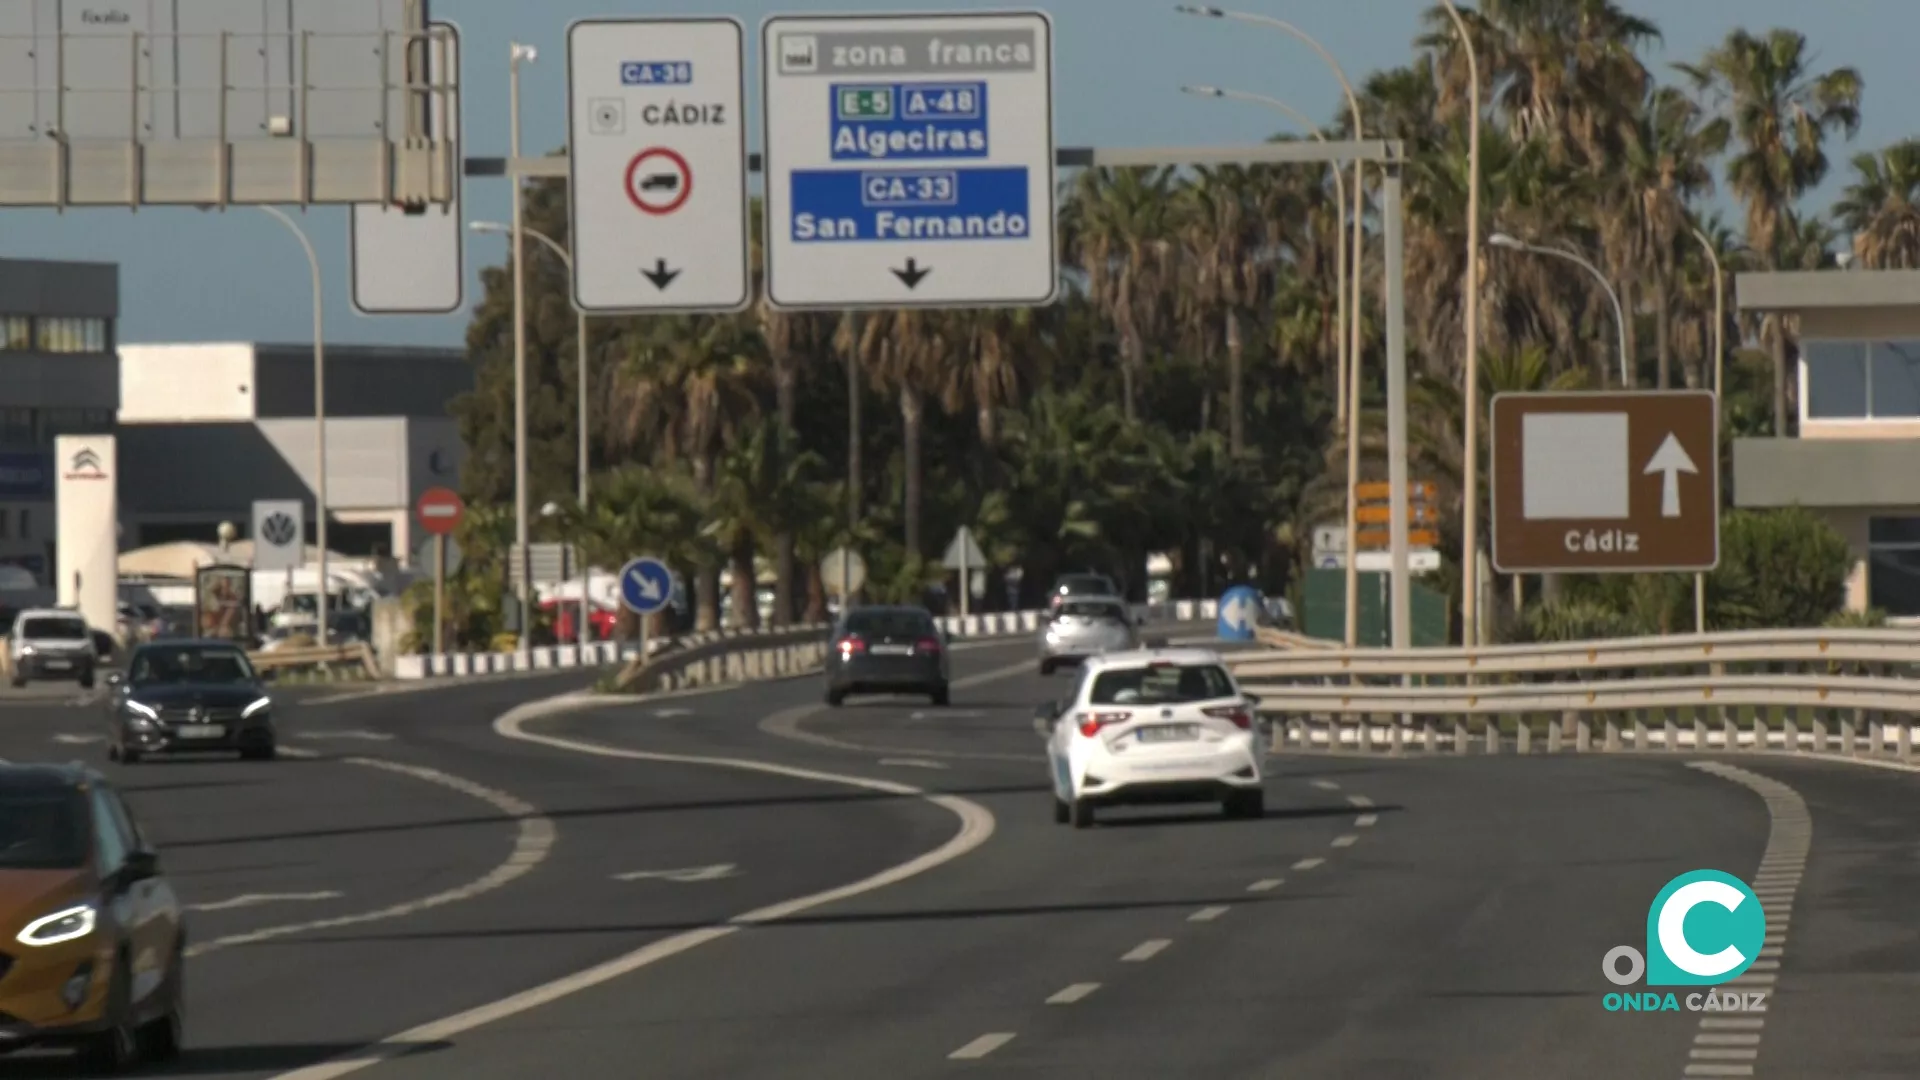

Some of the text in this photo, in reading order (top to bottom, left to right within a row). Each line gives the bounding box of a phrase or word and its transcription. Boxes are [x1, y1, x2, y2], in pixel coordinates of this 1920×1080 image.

[832, 37, 1031, 66] zona franca
[641, 97, 726, 126] CÁDIZ
[843, 89, 973, 114] E-5 A-48
[834, 124, 985, 158] Algeciras
[868, 177, 951, 200] CA-33
[795, 209, 1027, 238] San Fernando
[1564, 528, 1639, 553] Cádiz
